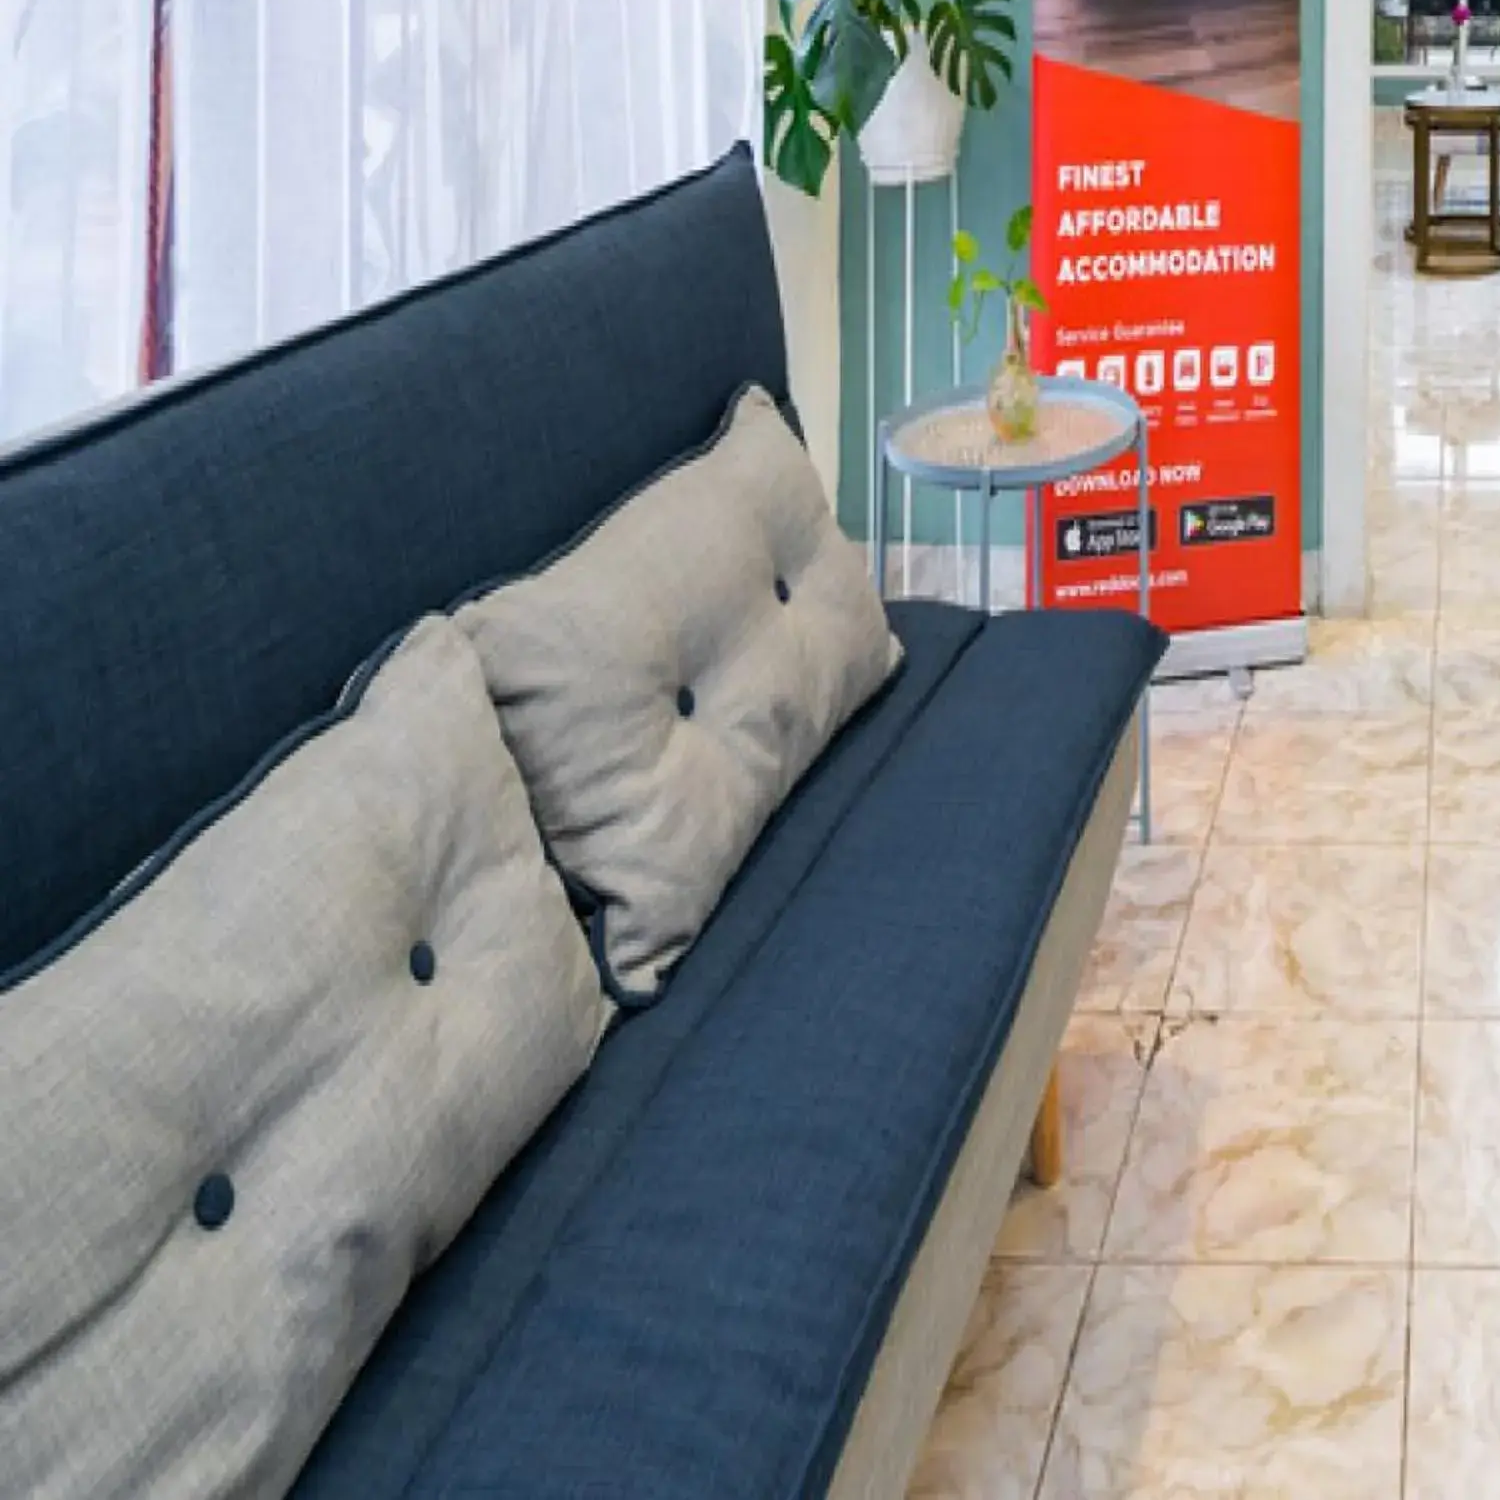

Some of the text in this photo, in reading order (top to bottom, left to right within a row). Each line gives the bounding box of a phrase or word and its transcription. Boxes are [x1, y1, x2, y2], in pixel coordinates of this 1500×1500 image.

[1057, 160, 1145, 191] FINEST
[1056, 200, 1221, 238] AFFORDABLE
[1056, 244, 1275, 284] ACCOMMODATION
[1159, 462, 1202, 485] NOW
